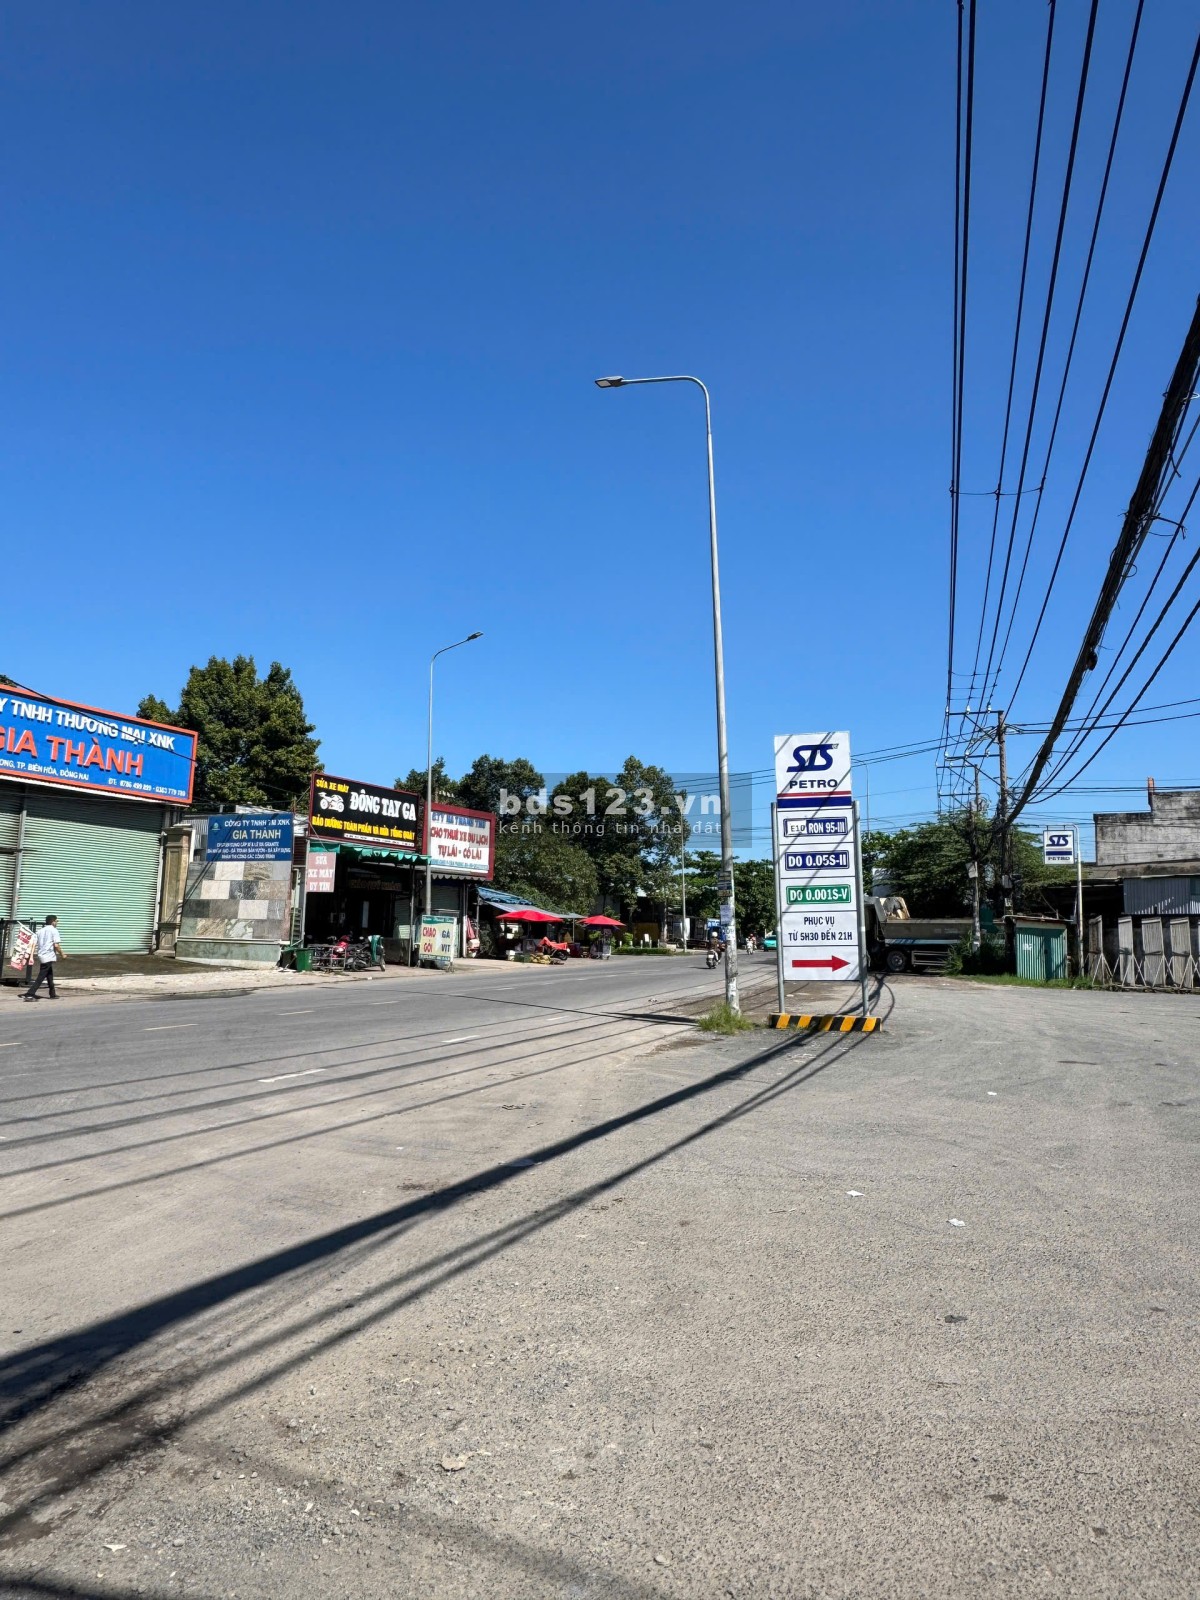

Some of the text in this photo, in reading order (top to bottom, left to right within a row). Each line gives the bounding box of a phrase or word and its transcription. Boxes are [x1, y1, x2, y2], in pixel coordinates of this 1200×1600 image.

[11, 699, 53, 723] TNHH
[55, 710, 119, 738] THƯƠNG
[121, 725, 146, 746] MẠI
[147, 731, 175, 751] XNK
[46, 735, 144, 777] THÀNH
[786, 743, 834, 773] STS
[27, 763, 43, 774] BIÊN
[78, 772, 90, 781] NAI
[316, 777, 328, 789] SỬA
[328, 782, 337, 790] XE
[789, 778, 838, 789] PETRO
[349, 788, 417, 821] ĐÔNG TAY GA
[251, 819, 266, 827] TNHH
[808, 822, 824, 833] RON
[232, 827, 282, 840] GIA THÀNH
[430, 826, 443, 838] CHO
[459, 831, 467, 842] XE
[1046, 834, 1069, 847] STS
[463, 847, 471, 859] CÓ
[806, 854, 846, 867] 0.05S-II
[806, 888, 848, 900] 0.001S-V
[803, 916, 835, 927] PHỤC VỤ
[788, 927, 853, 941] TỪ 5H30 ĐẾN 21H
